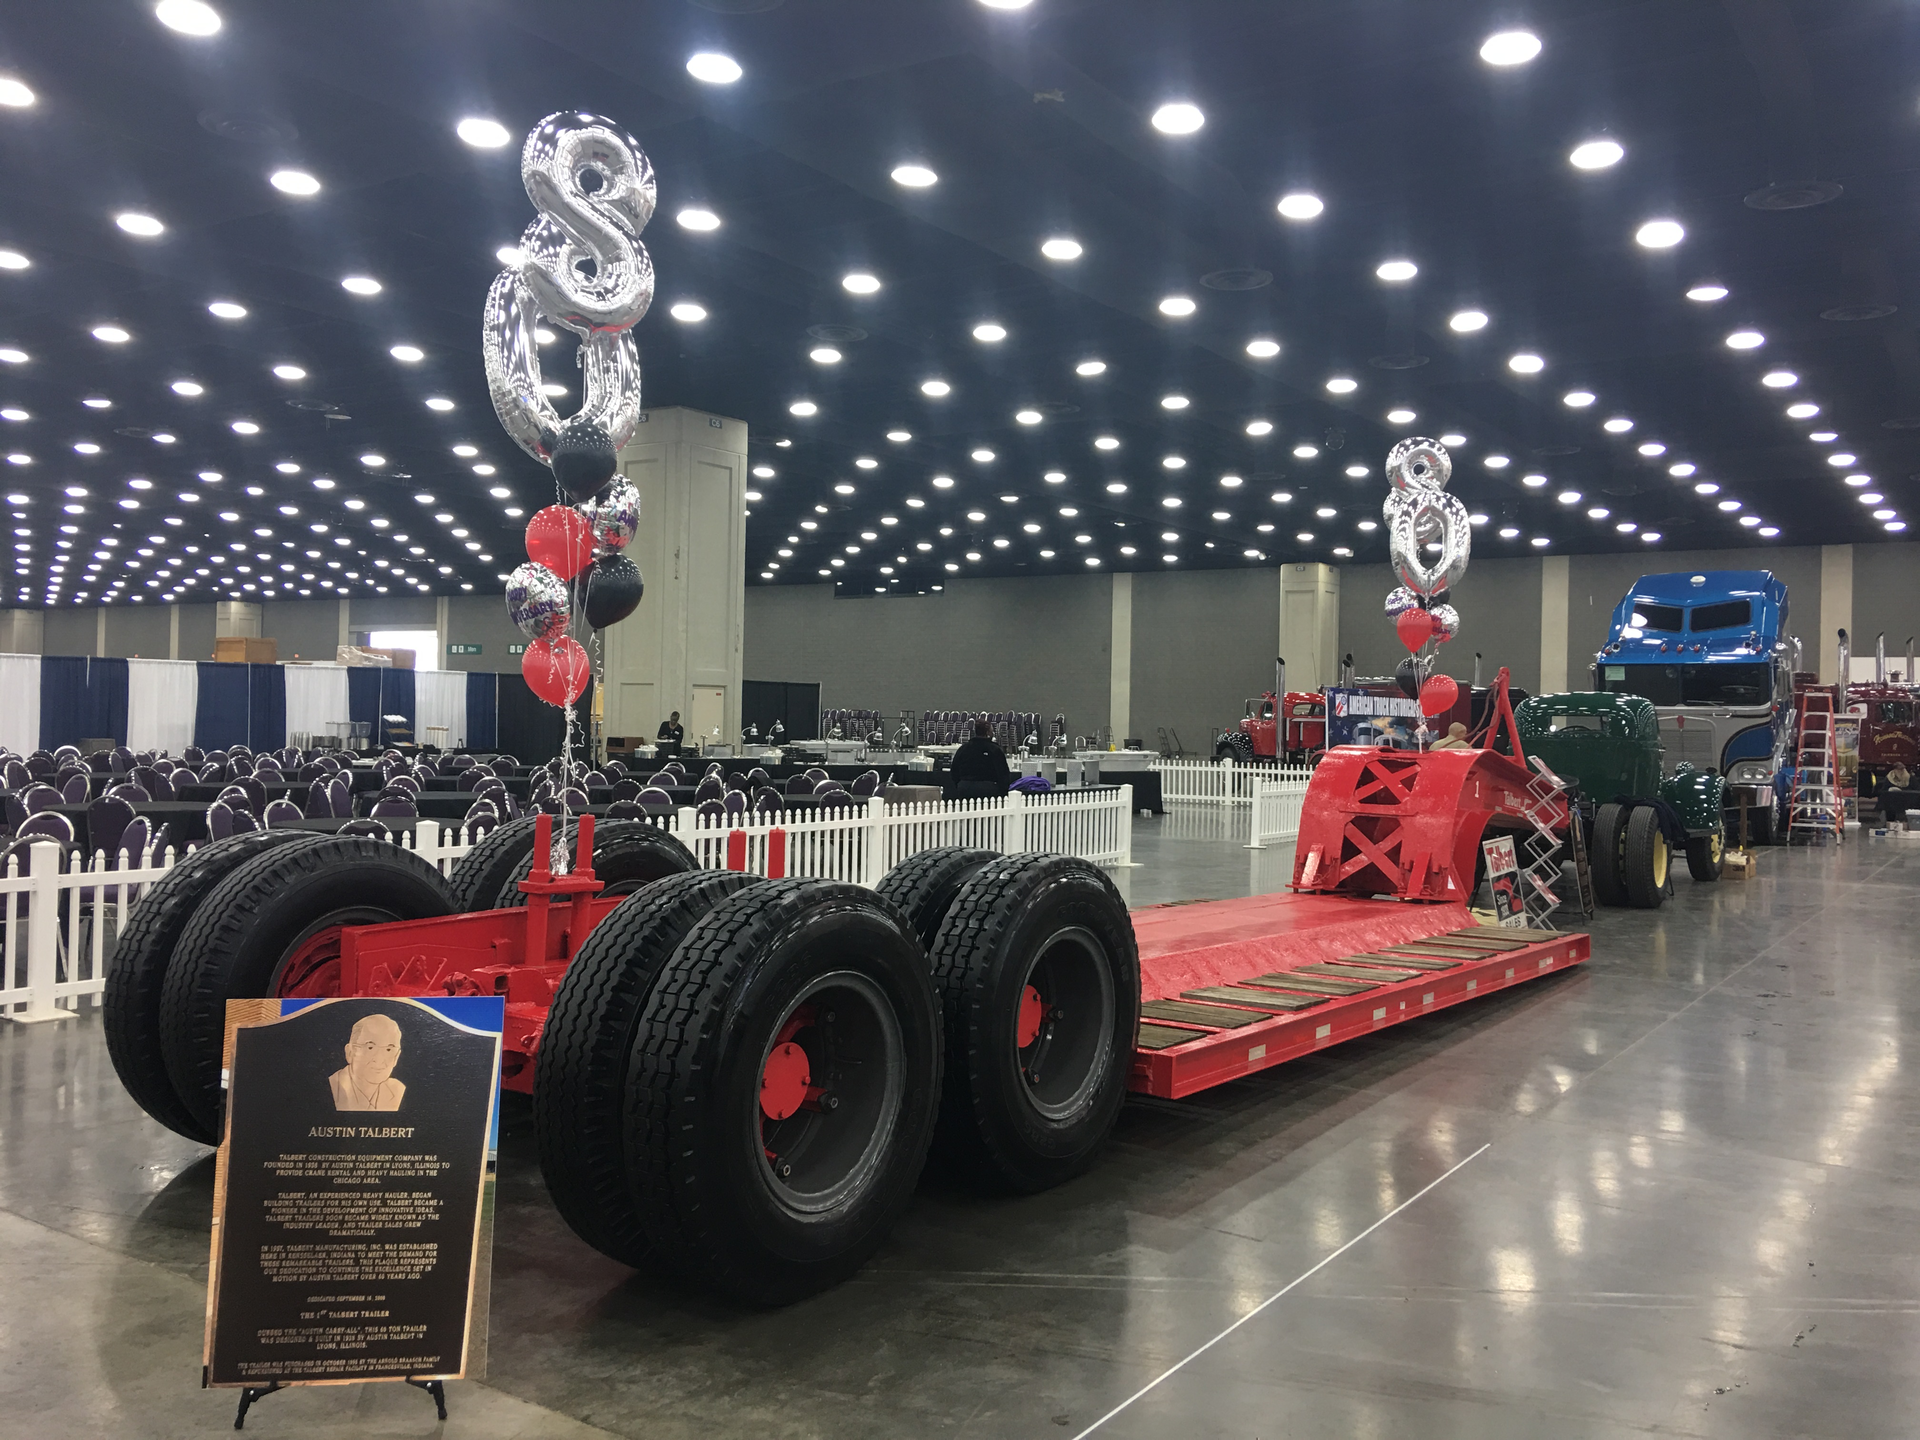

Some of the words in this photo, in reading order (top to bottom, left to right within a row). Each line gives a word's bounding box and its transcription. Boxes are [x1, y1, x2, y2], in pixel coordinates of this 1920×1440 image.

[1348, 695, 1374, 716] AMERICAN
[1374, 697, 1390, 716] TRUCK
[1474, 780, 1479, 798] 1
[1503, 791, 1522, 809] Talbert
[1485, 845, 1515, 874] Talbert
[308, 1127, 356, 1137] AUSTIN
[359, 1127, 414, 1138] TALBERT
